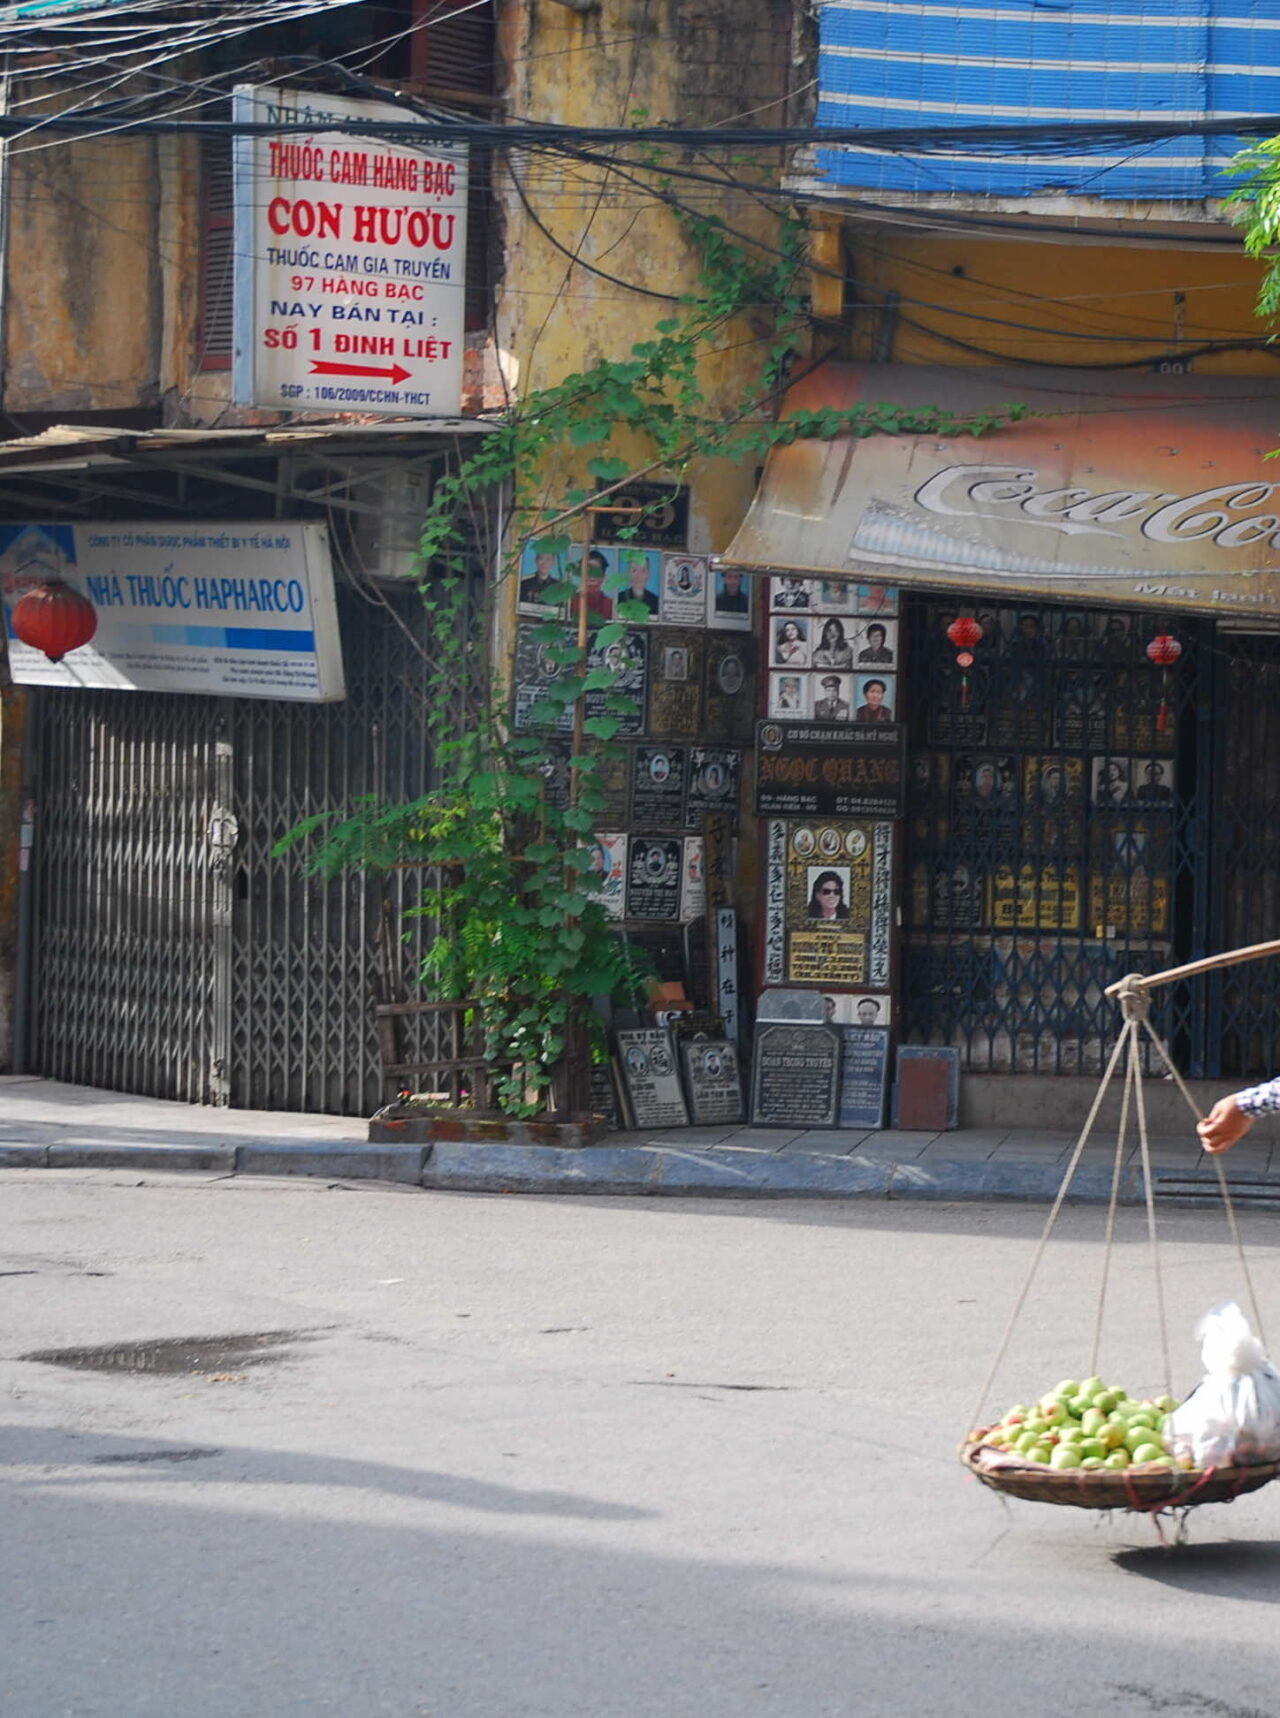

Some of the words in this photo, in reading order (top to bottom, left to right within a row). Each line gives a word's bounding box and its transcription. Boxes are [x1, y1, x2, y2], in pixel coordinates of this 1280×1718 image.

[330, 149, 368, 186] CAM
[423, 160, 457, 202] BẠC
[268, 196, 343, 241] CON
[353, 205, 456, 251] HƯƠU
[324, 252, 359, 273] CAM
[363, 256, 389, 275] GIA
[291, 275, 315, 292] 97
[321, 275, 379, 297] HÀNG
[385, 282, 425, 303] BẠC
[270, 300, 323, 318] NAY
[332, 302, 381, 323] BÁN
[387, 308, 424, 329] TẠI
[264, 323, 299, 350] SỐ
[308, 327, 323, 351] 1
[335, 333, 395, 357] ĐINH
[403, 335, 452, 363] LIỆT
[126, 562, 191, 609] THUỐC
[195, 577, 304, 613] HAPHARCO
